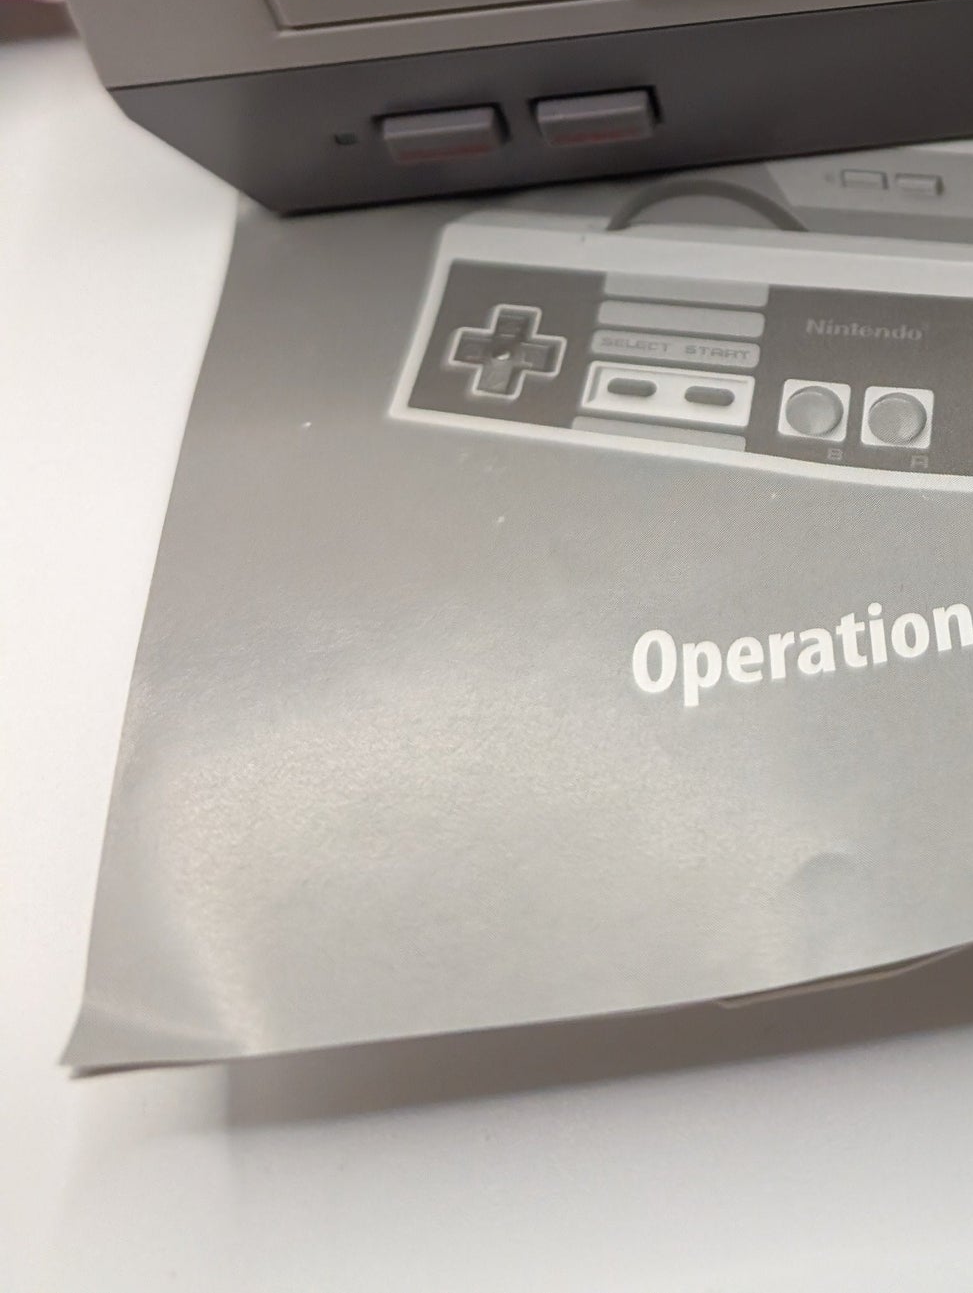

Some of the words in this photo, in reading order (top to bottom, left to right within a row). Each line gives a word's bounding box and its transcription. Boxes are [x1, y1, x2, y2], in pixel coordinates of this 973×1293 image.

[805, 316, 924, 341] Nintendo
[601, 337, 671, 353] SELECT
[684, 344, 750, 360] START
